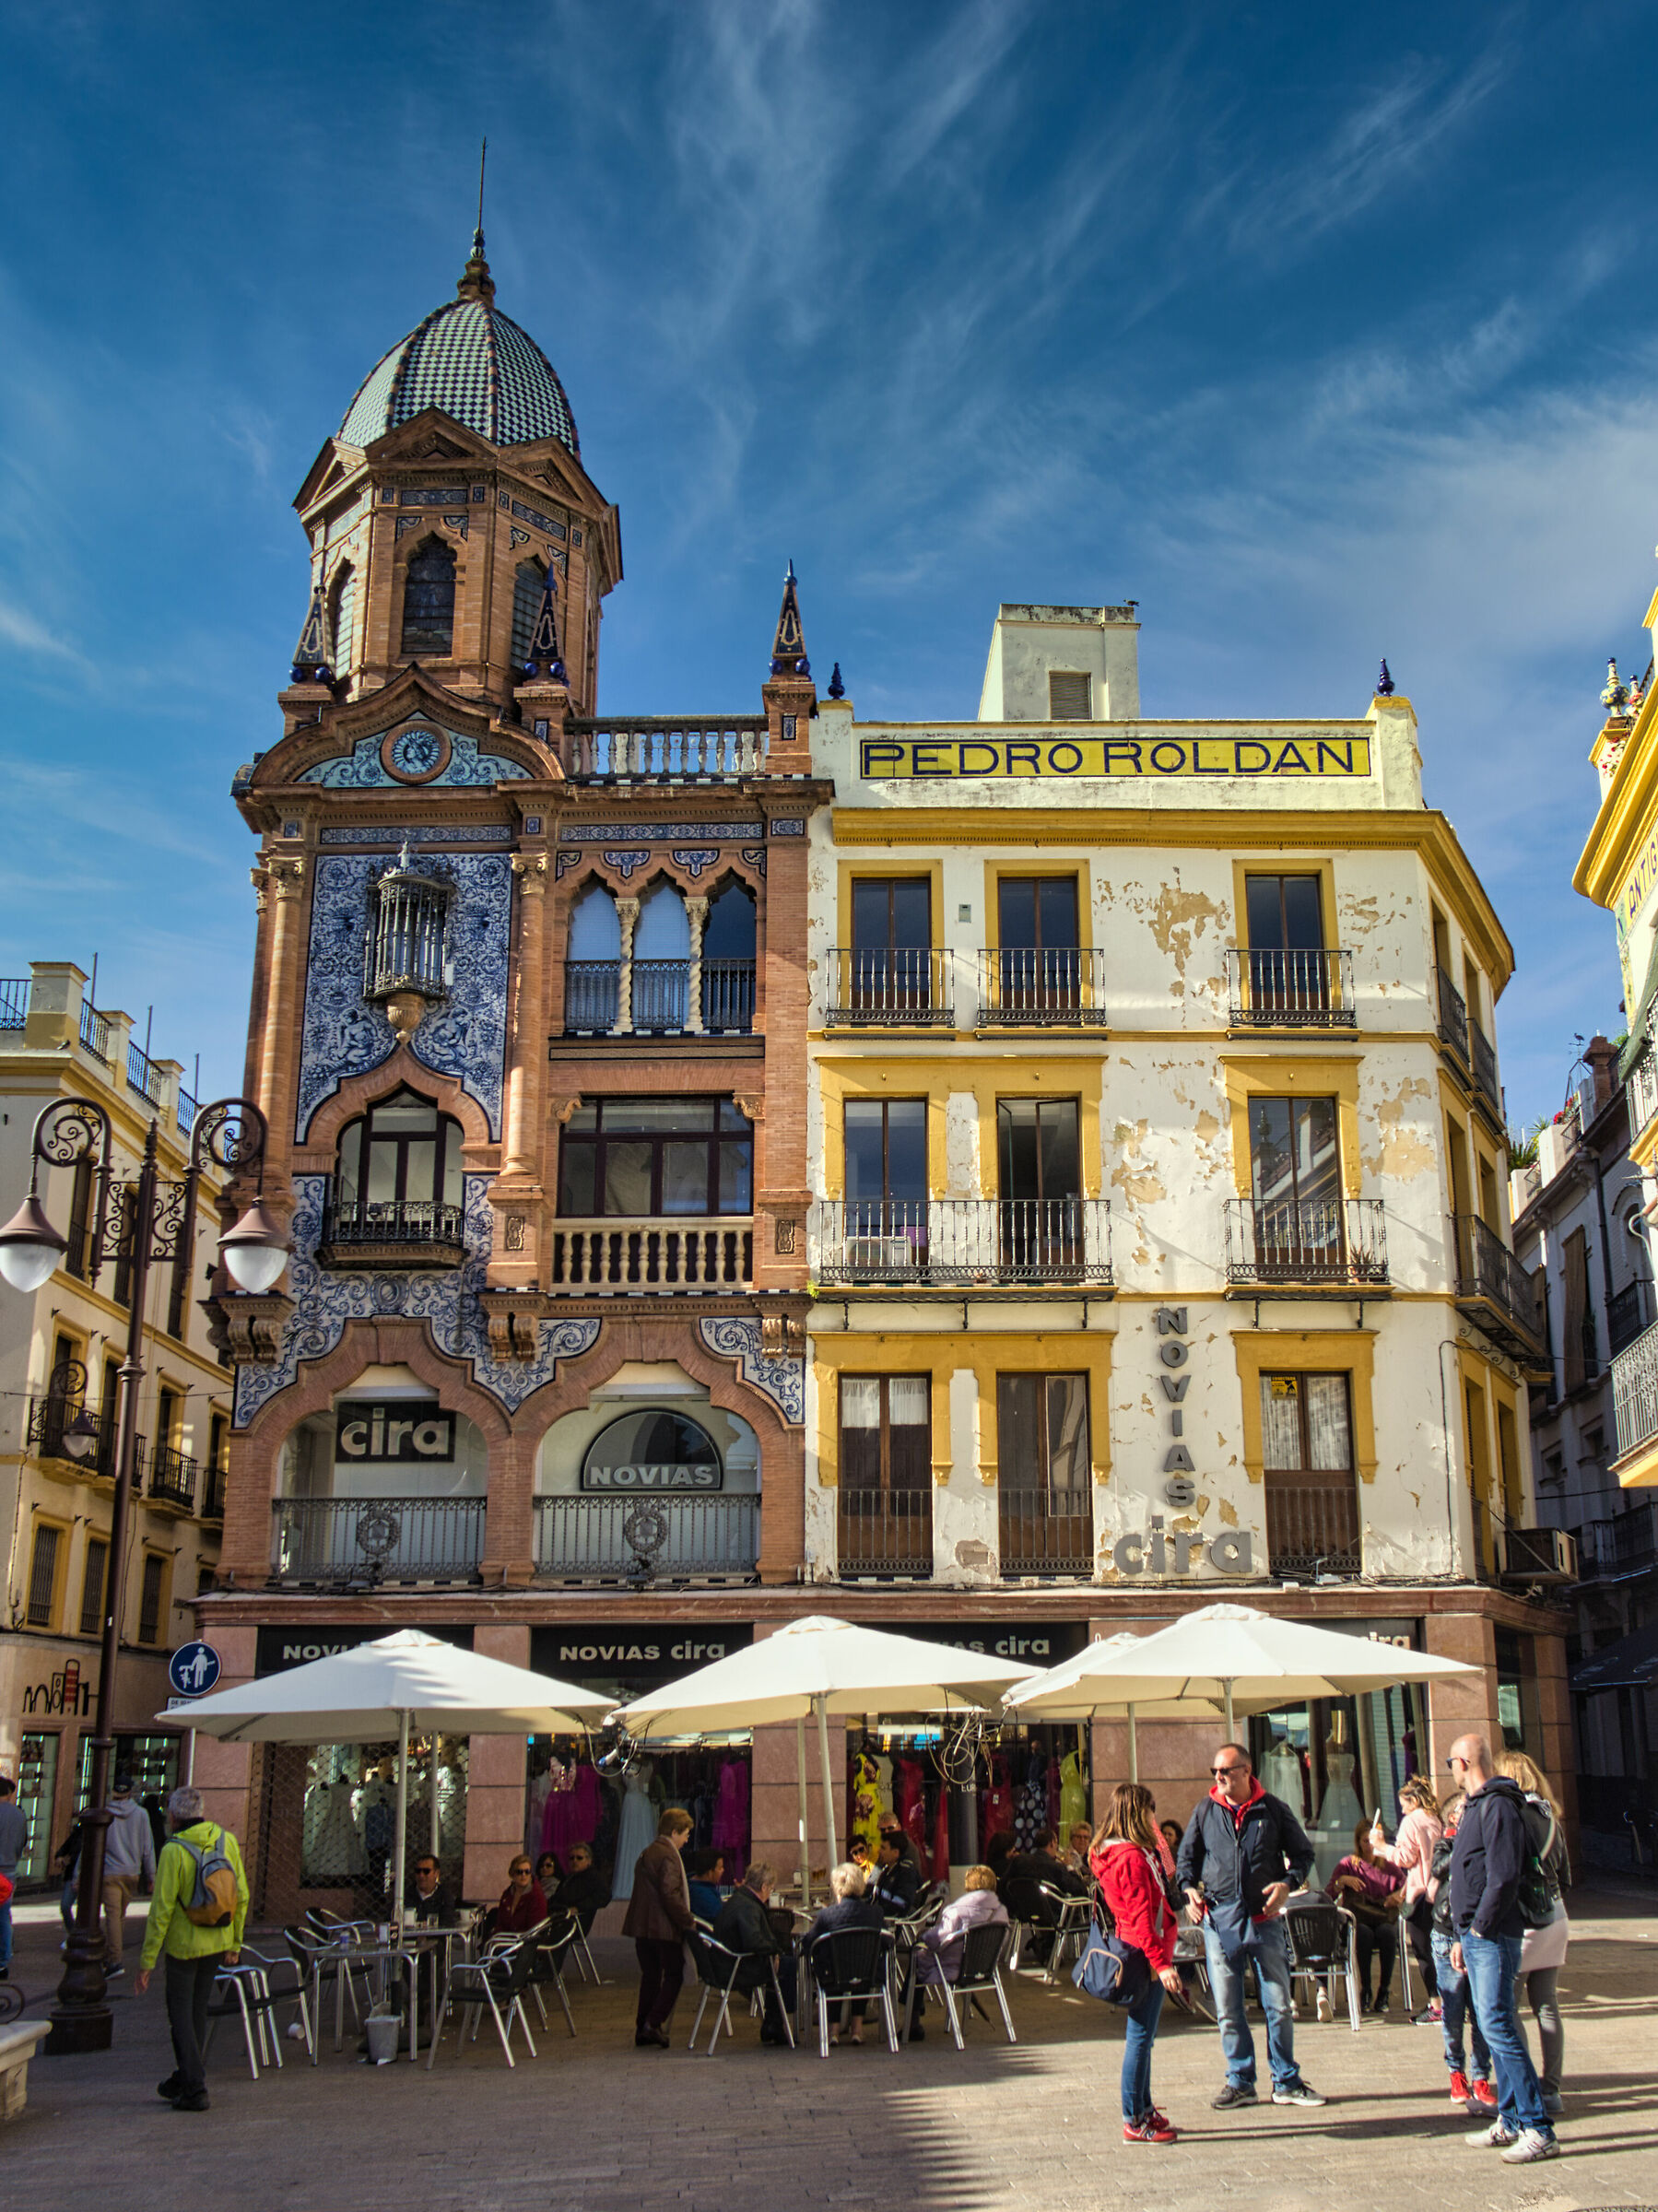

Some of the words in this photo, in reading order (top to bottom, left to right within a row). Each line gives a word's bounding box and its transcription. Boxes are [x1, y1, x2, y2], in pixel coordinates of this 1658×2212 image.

[863, 742, 1084, 776] PEDRO
[1103, 741, 1356, 775] ROLDAN
[1158, 1306, 1196, 1508] NOVIAS
[340, 1407, 450, 1456] cira
[589, 1465, 713, 1487] NOVIAS
[1113, 1514, 1252, 1575] cira
[559, 1644, 661, 1661] NOVIAS
[670, 1640, 725, 1660] cira
[994, 1635, 1051, 1655] cira
